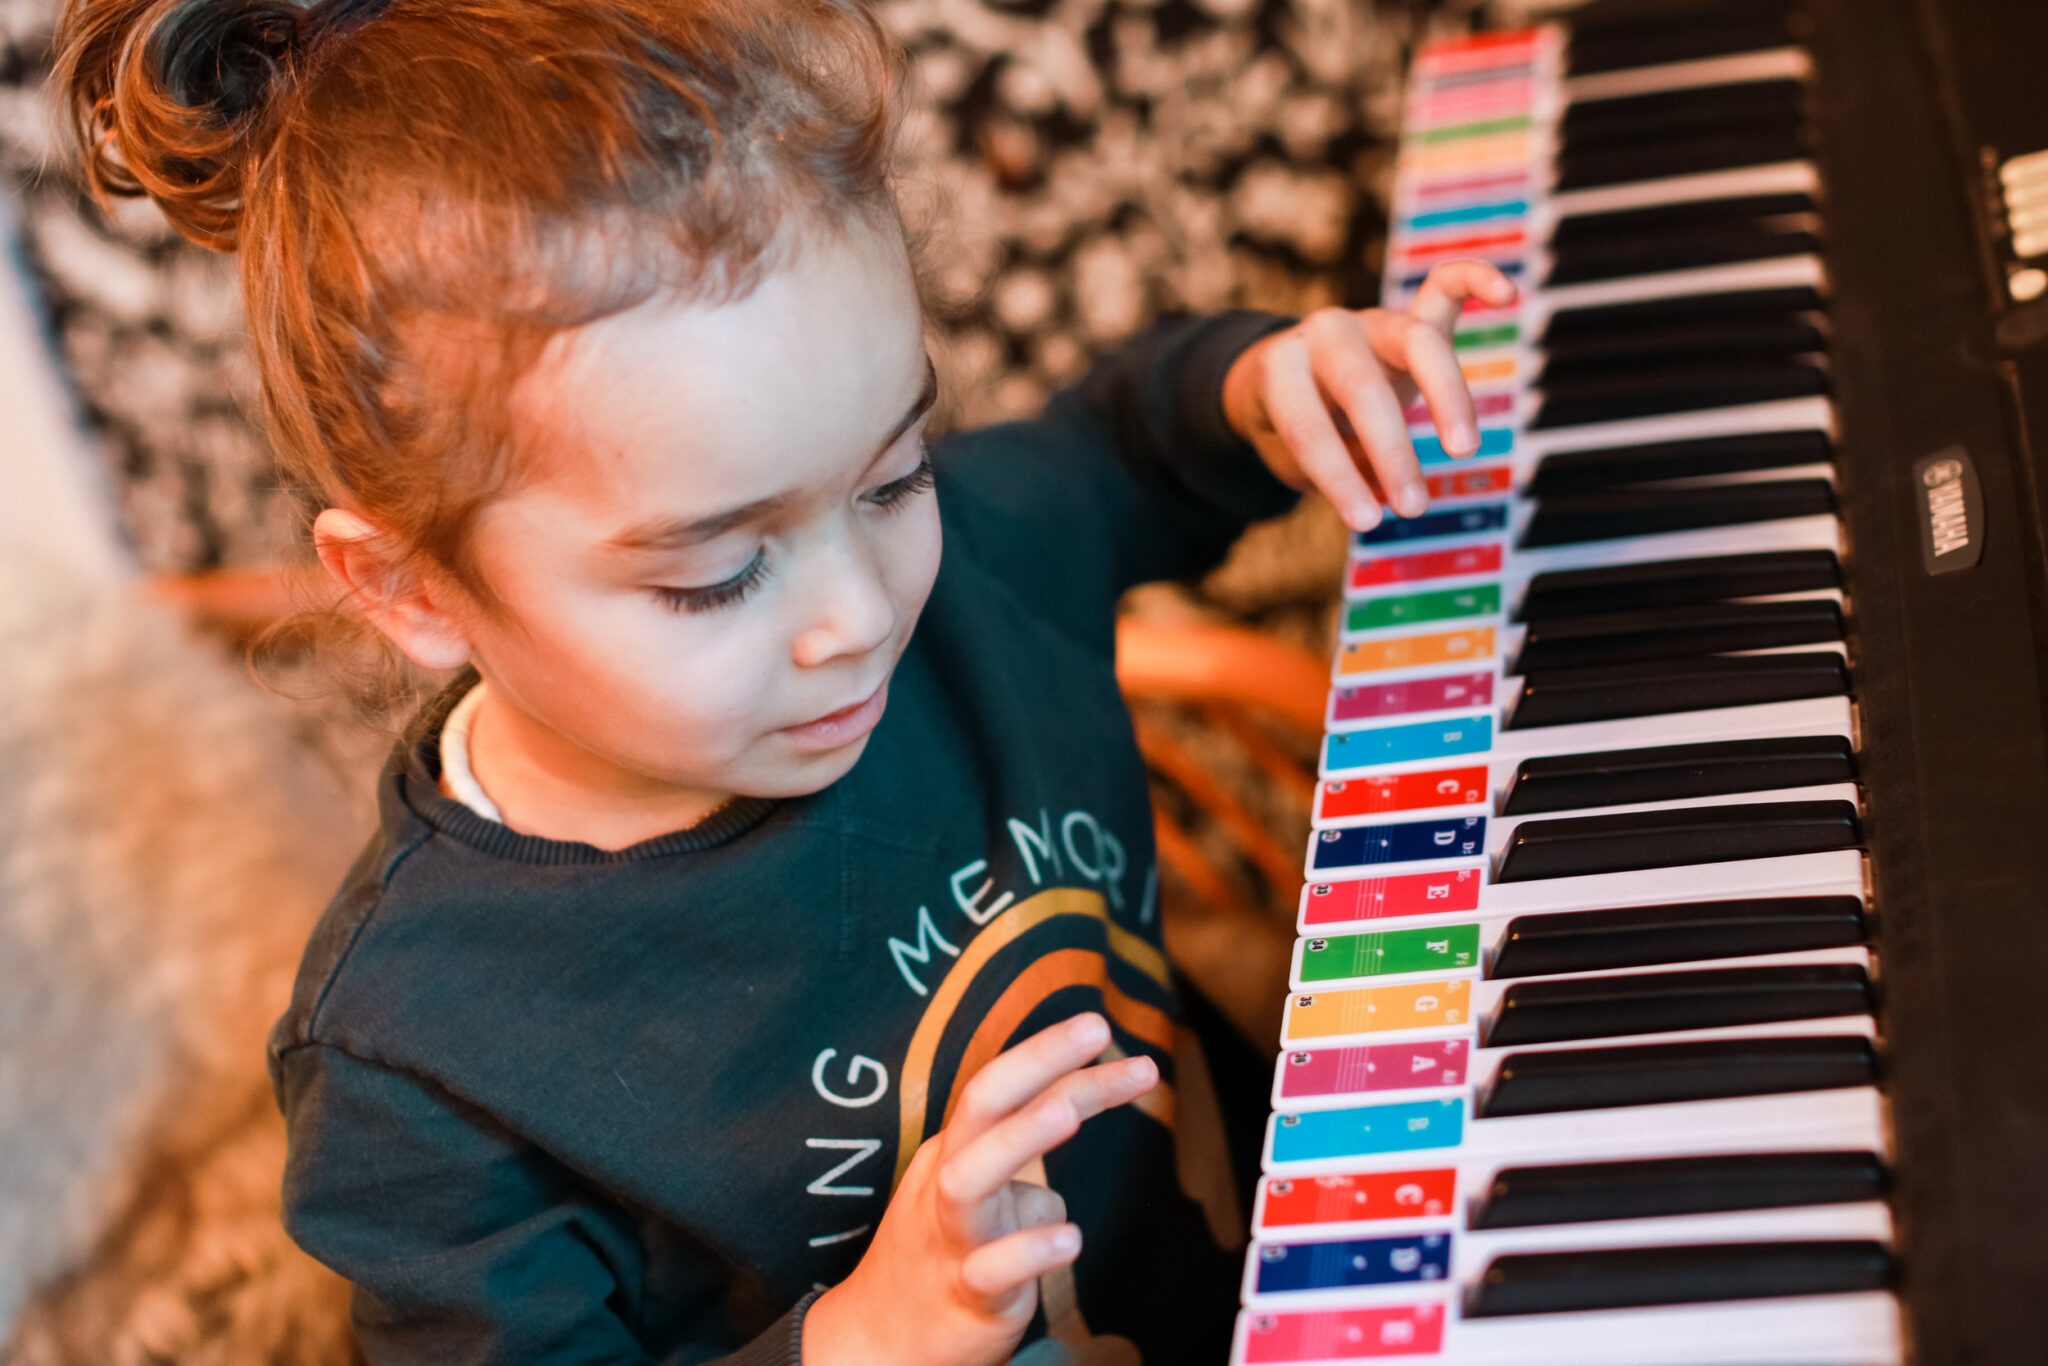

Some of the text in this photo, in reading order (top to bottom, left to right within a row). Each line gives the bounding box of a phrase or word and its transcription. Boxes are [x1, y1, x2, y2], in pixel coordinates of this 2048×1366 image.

[1928, 478, 1969, 557] YAMAHA
[1437, 779, 1460, 795] C
[1433, 830, 1457, 846] D
[1316, 884, 1329, 895] 33
[1426, 884, 1450, 900] E
[1311, 939, 1325, 951] 34
[1426, 939, 1449, 954] F
[1300, 996, 1312, 1007] 35
[1414, 995, 1439, 1012] G
[1411, 1055, 1437, 1073] A
[1394, 1183, 1424, 1206] C
[1389, 1246, 1422, 1273] D
